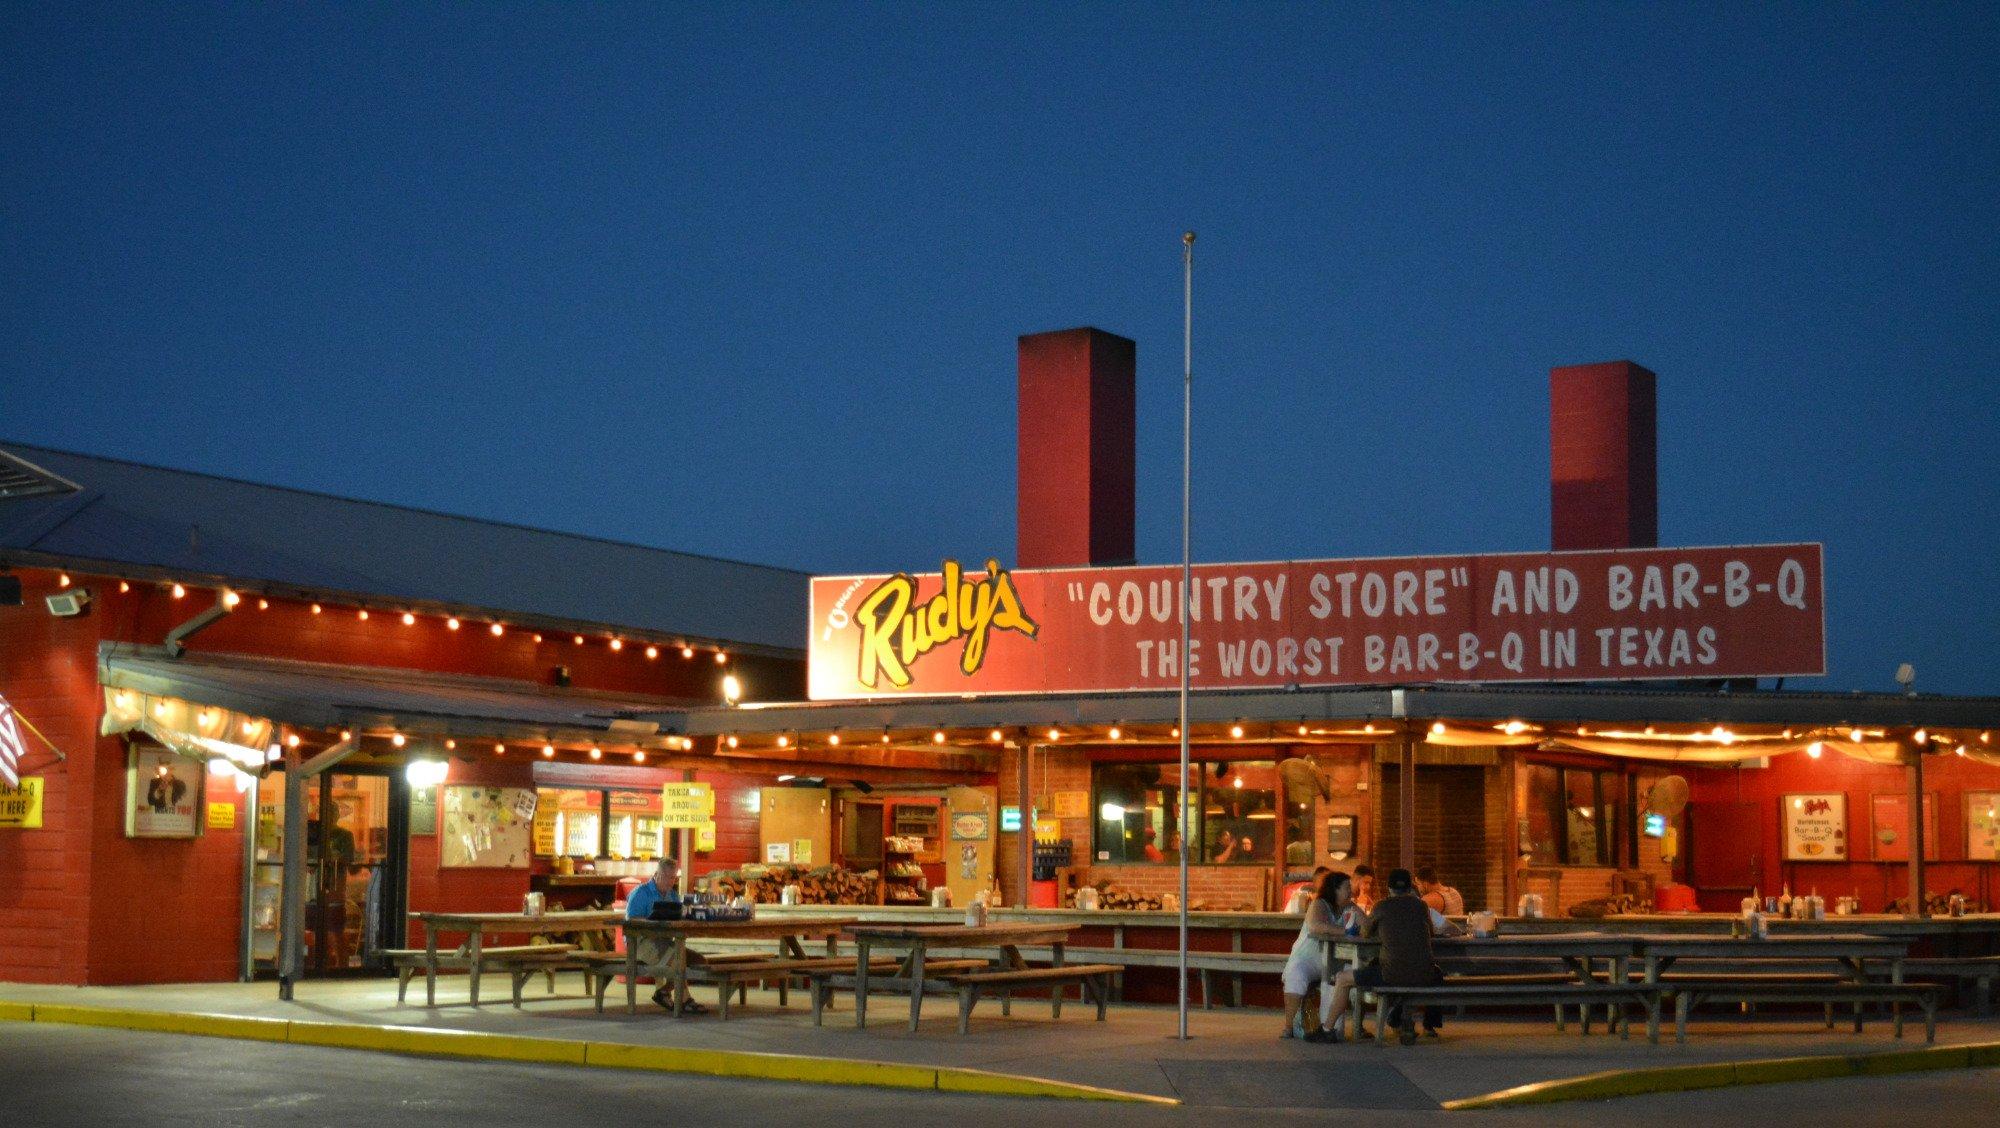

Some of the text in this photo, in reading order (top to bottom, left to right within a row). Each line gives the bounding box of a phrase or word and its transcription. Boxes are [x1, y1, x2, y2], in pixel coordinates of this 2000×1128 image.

[1067, 557, 1808, 627] "COUNTRY STORE" AND BAR-B-Q
[855, 559, 1040, 690] Rudy's
[1136, 626, 1719, 679] THE WORST BAR-B-Q IN TEXAS
[7, 800, 26, 814] HERE
[664, 814, 674, 823] ON
[675, 814, 690, 823] THE
